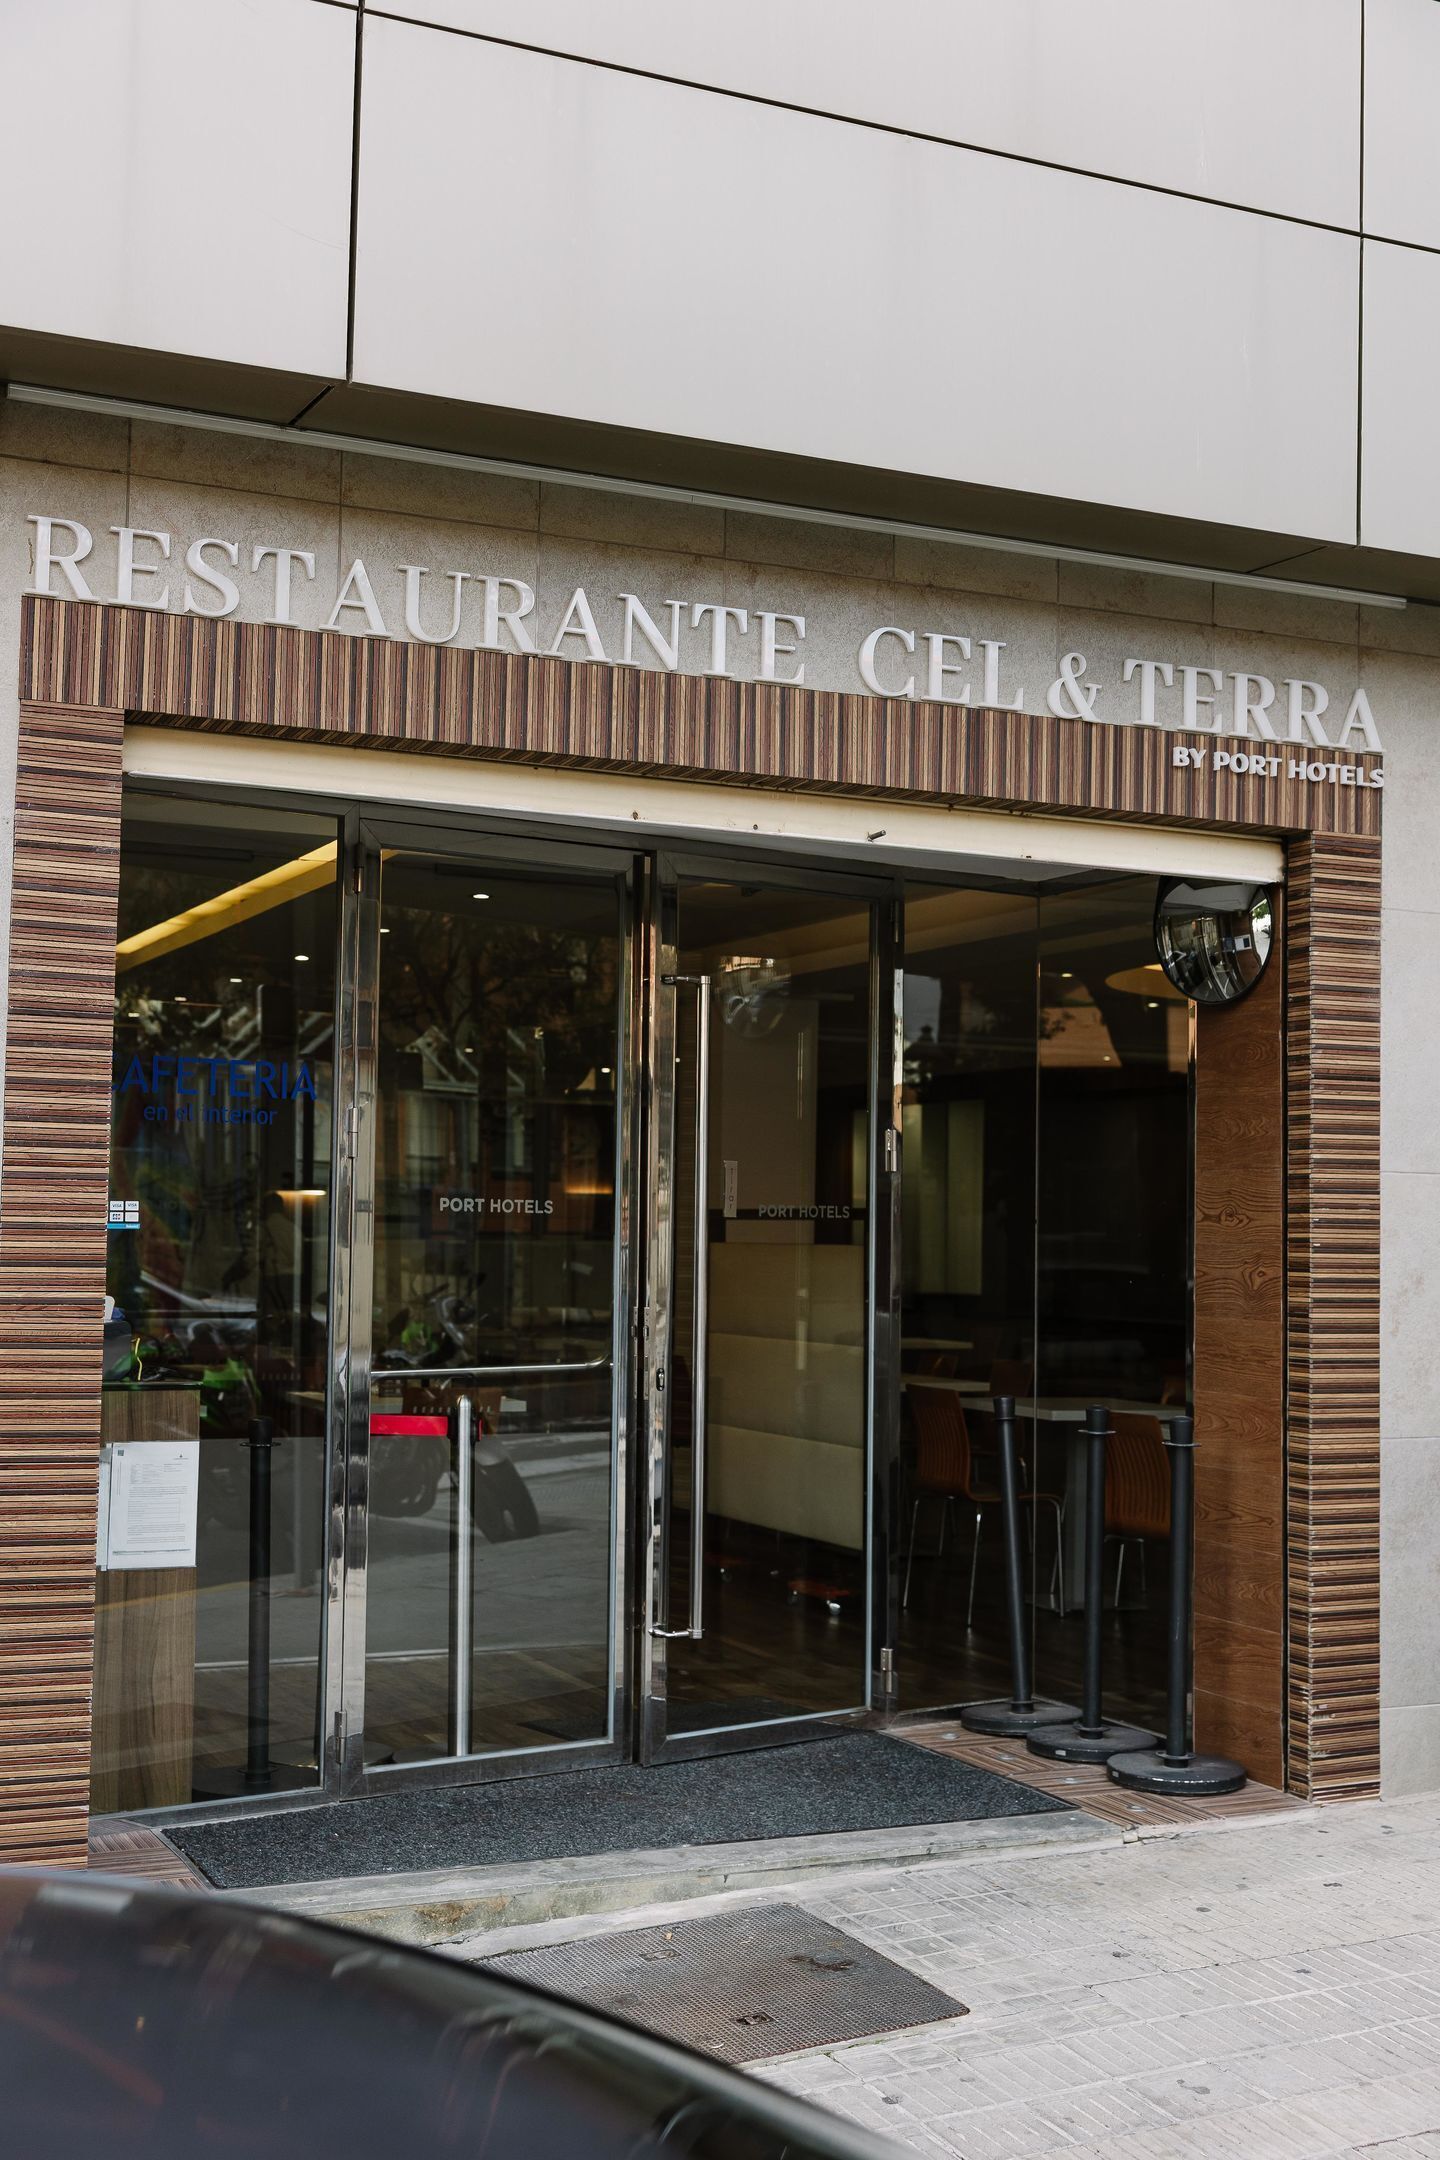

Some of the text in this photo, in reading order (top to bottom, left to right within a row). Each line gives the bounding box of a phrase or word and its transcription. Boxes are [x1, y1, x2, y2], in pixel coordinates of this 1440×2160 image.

[26, 514, 1385, 754] RESTAURANTE CEL & TERRA
[1172, 746, 1385, 789] BY PORT HOTELS
[111, 1052, 318, 1101] AFETERIA
[143, 1103, 278, 1126] en el interior
[439, 1197, 554, 1215] PORT HOTELS
[758, 1204, 850, 1219] PORT HOTELS
